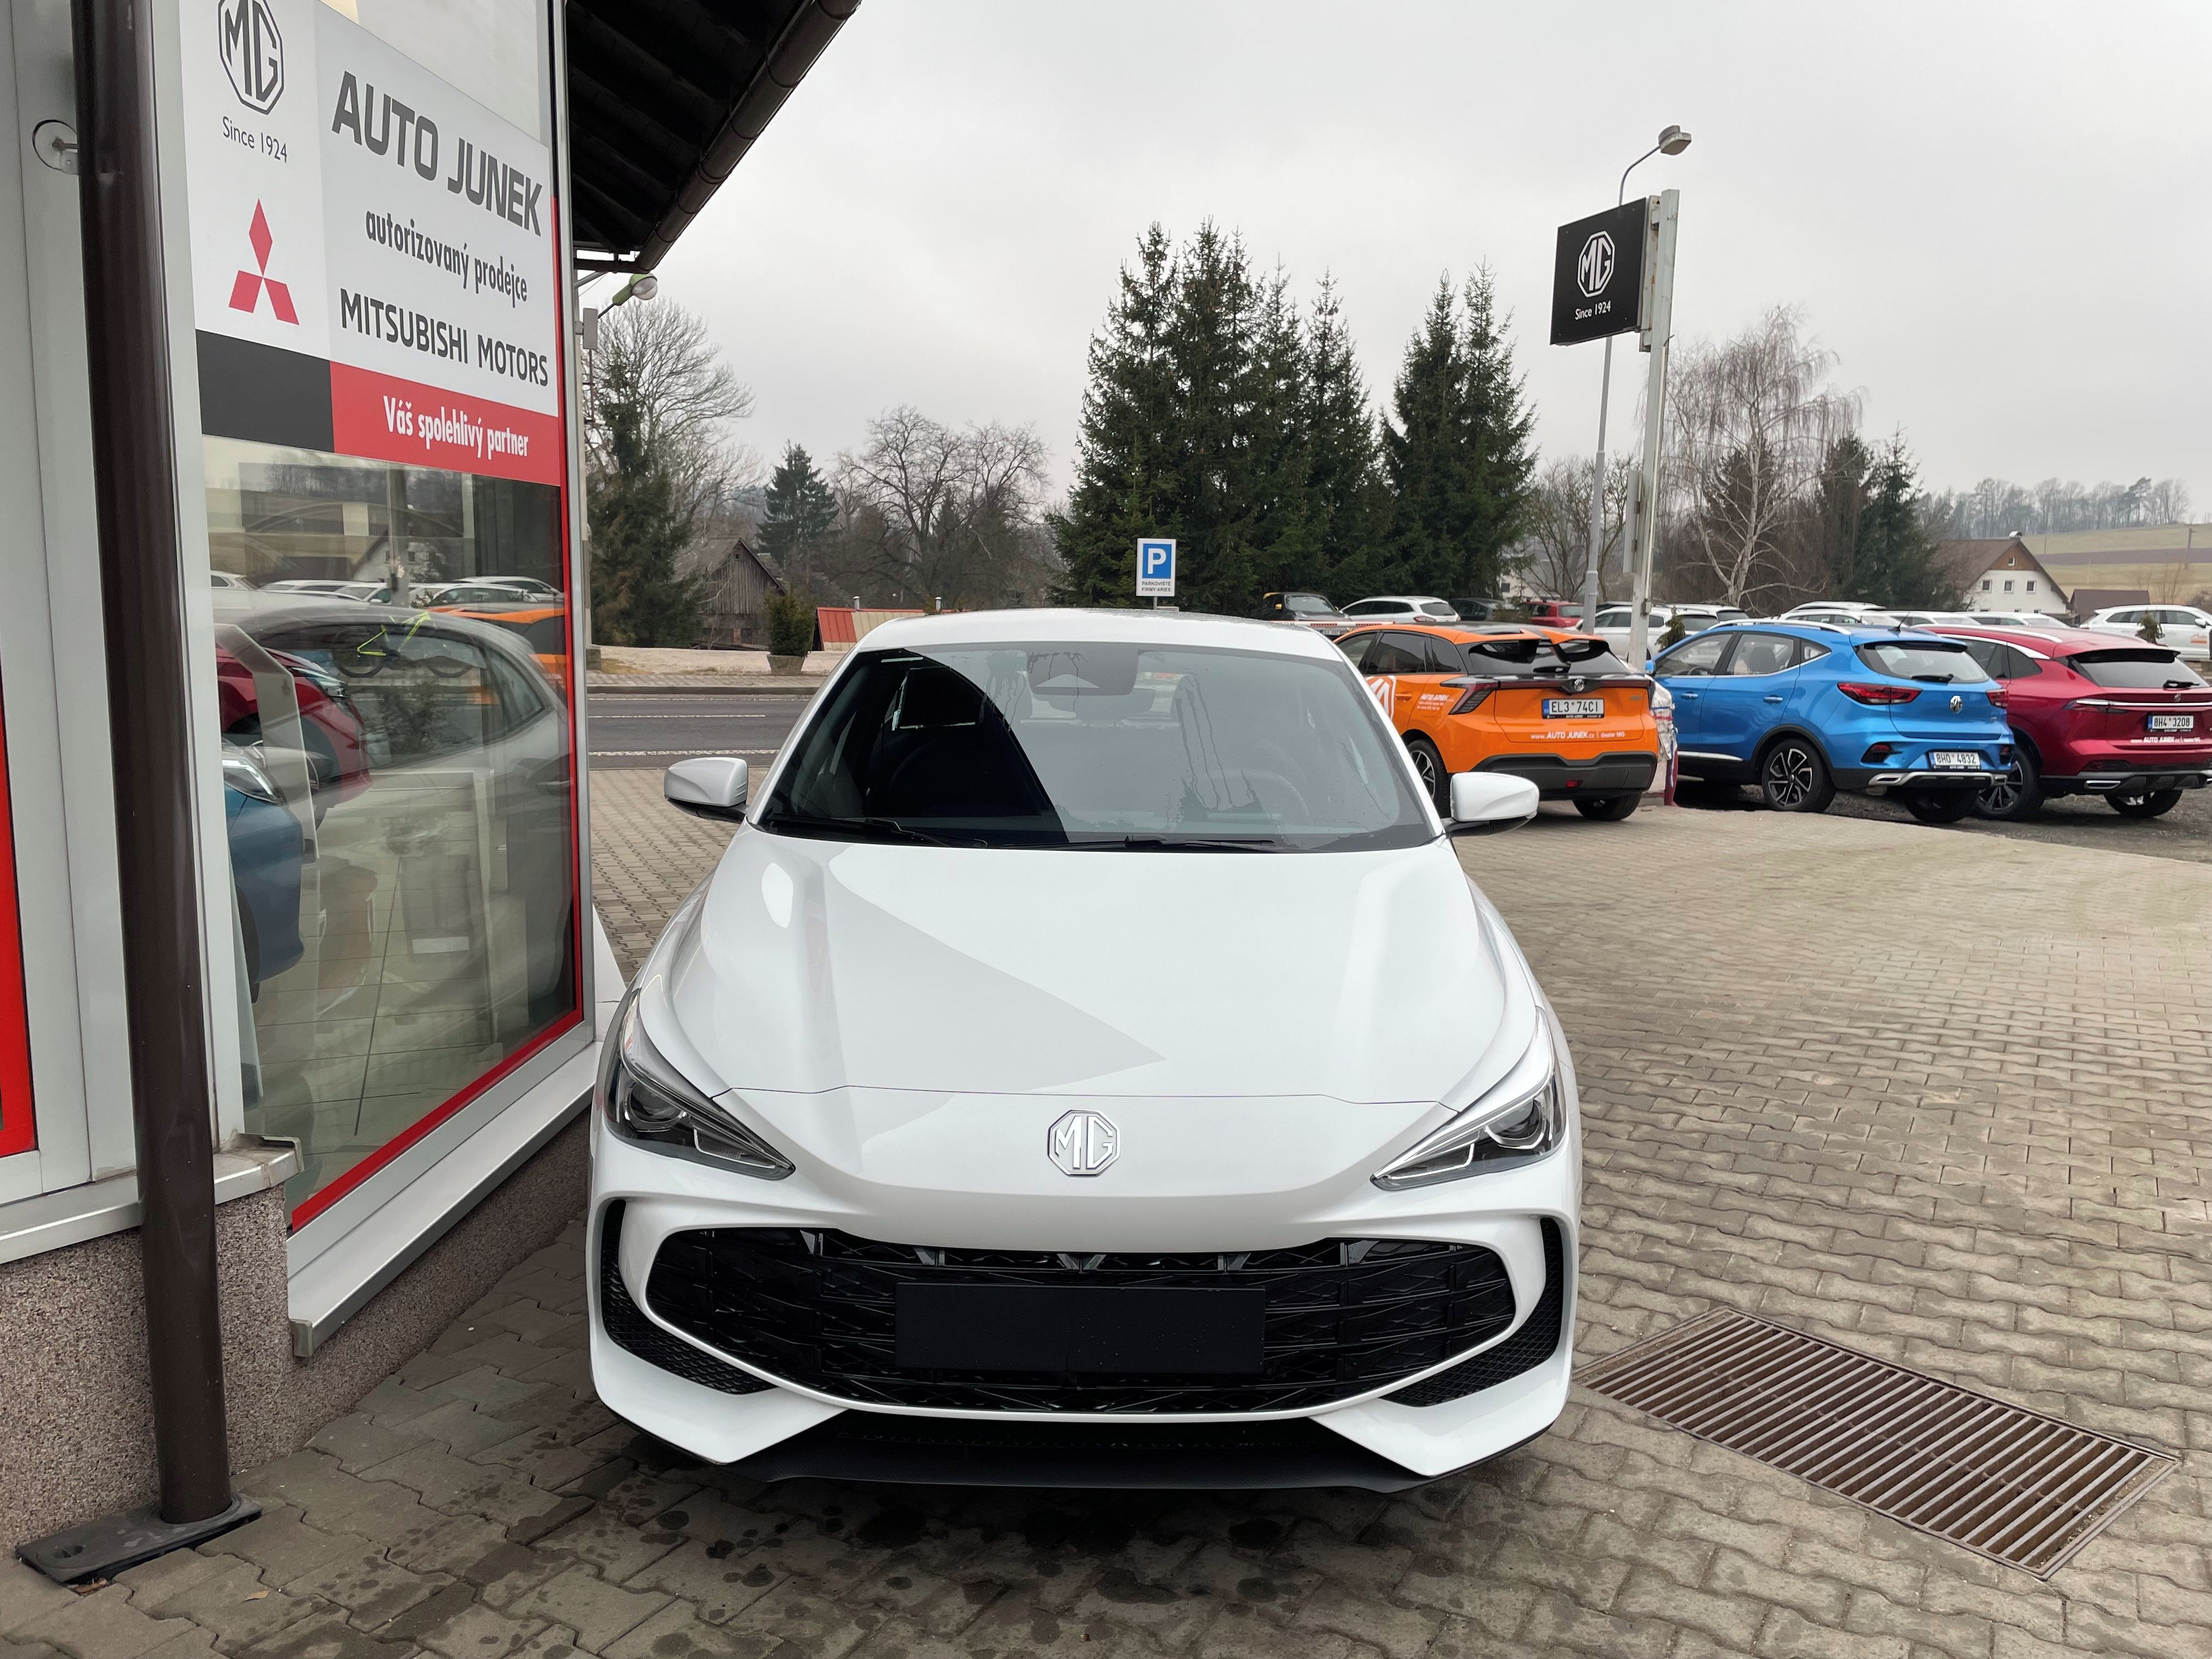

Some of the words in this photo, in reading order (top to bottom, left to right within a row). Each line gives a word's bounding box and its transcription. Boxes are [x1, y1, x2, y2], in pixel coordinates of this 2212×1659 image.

[225, 0, 278, 103] MG
[223, 116, 255, 149] Since
[261, 132, 287, 163] 1924
[331, 70, 438, 181] AUTO
[447, 137, 542, 236] JUNEK
[366, 209, 470, 289] autorizovaný
[475, 255, 528, 308] prodejce
[1581, 237, 1612, 291] MG
[340, 288, 468, 364] MITSUBISHI
[478, 334, 548, 387] MOTORS
[1575, 308, 1593, 320] Since
[1595, 300, 1611, 315] 1924
[383, 395, 413, 437] Váš
[418, 407, 484, 459] spolehlivý
[487, 428, 529, 460] partner
[1147, 548, 1166, 574] P
[1053, 1115, 1113, 1170] MG
